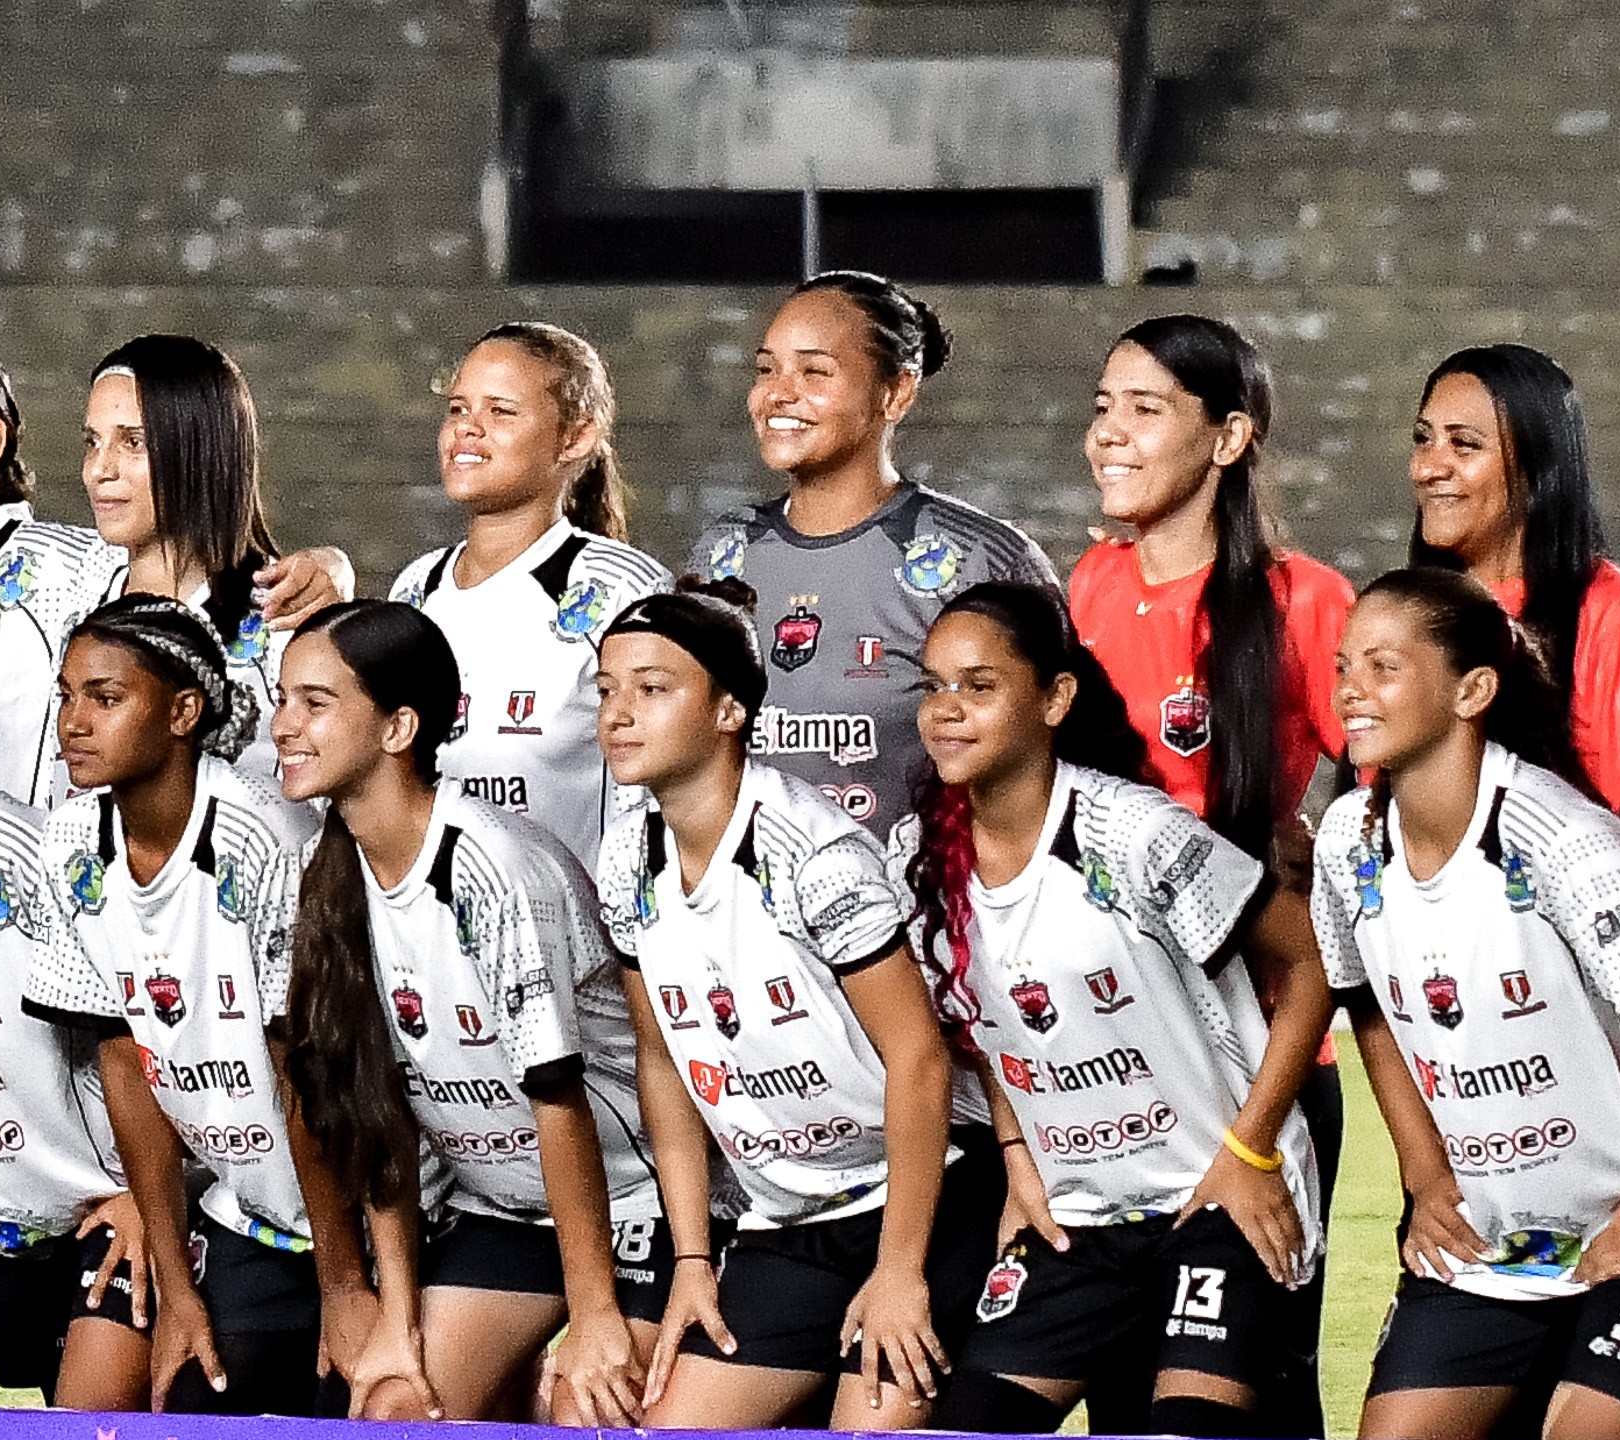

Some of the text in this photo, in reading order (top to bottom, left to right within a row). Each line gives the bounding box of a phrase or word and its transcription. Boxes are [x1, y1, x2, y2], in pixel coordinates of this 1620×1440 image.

[1050, 1104, 1174, 1150] LOTEP
[1447, 1120, 1572, 1161] LOTEP
[1171, 1264, 1227, 1320] 13
